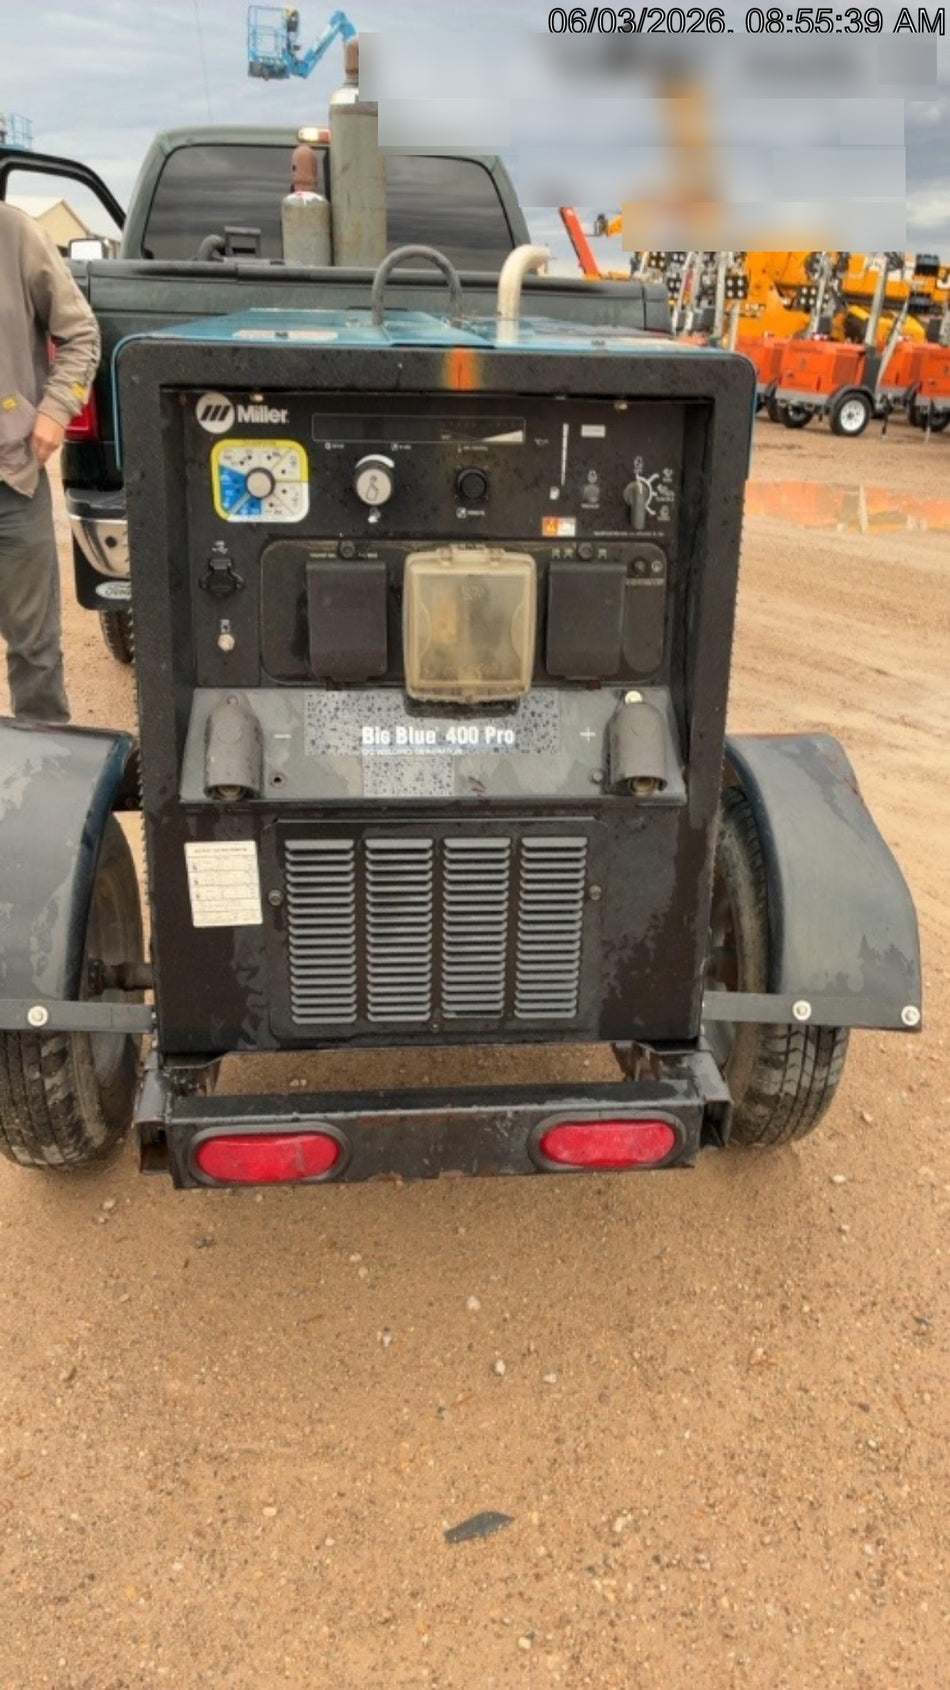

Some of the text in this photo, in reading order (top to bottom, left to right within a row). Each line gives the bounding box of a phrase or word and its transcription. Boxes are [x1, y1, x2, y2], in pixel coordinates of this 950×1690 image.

[236, 404, 289, 424] Miller
[395, 725, 437, 745] Blue
[446, 725, 479, 745] 400
[484, 725, 516, 745] Pro
